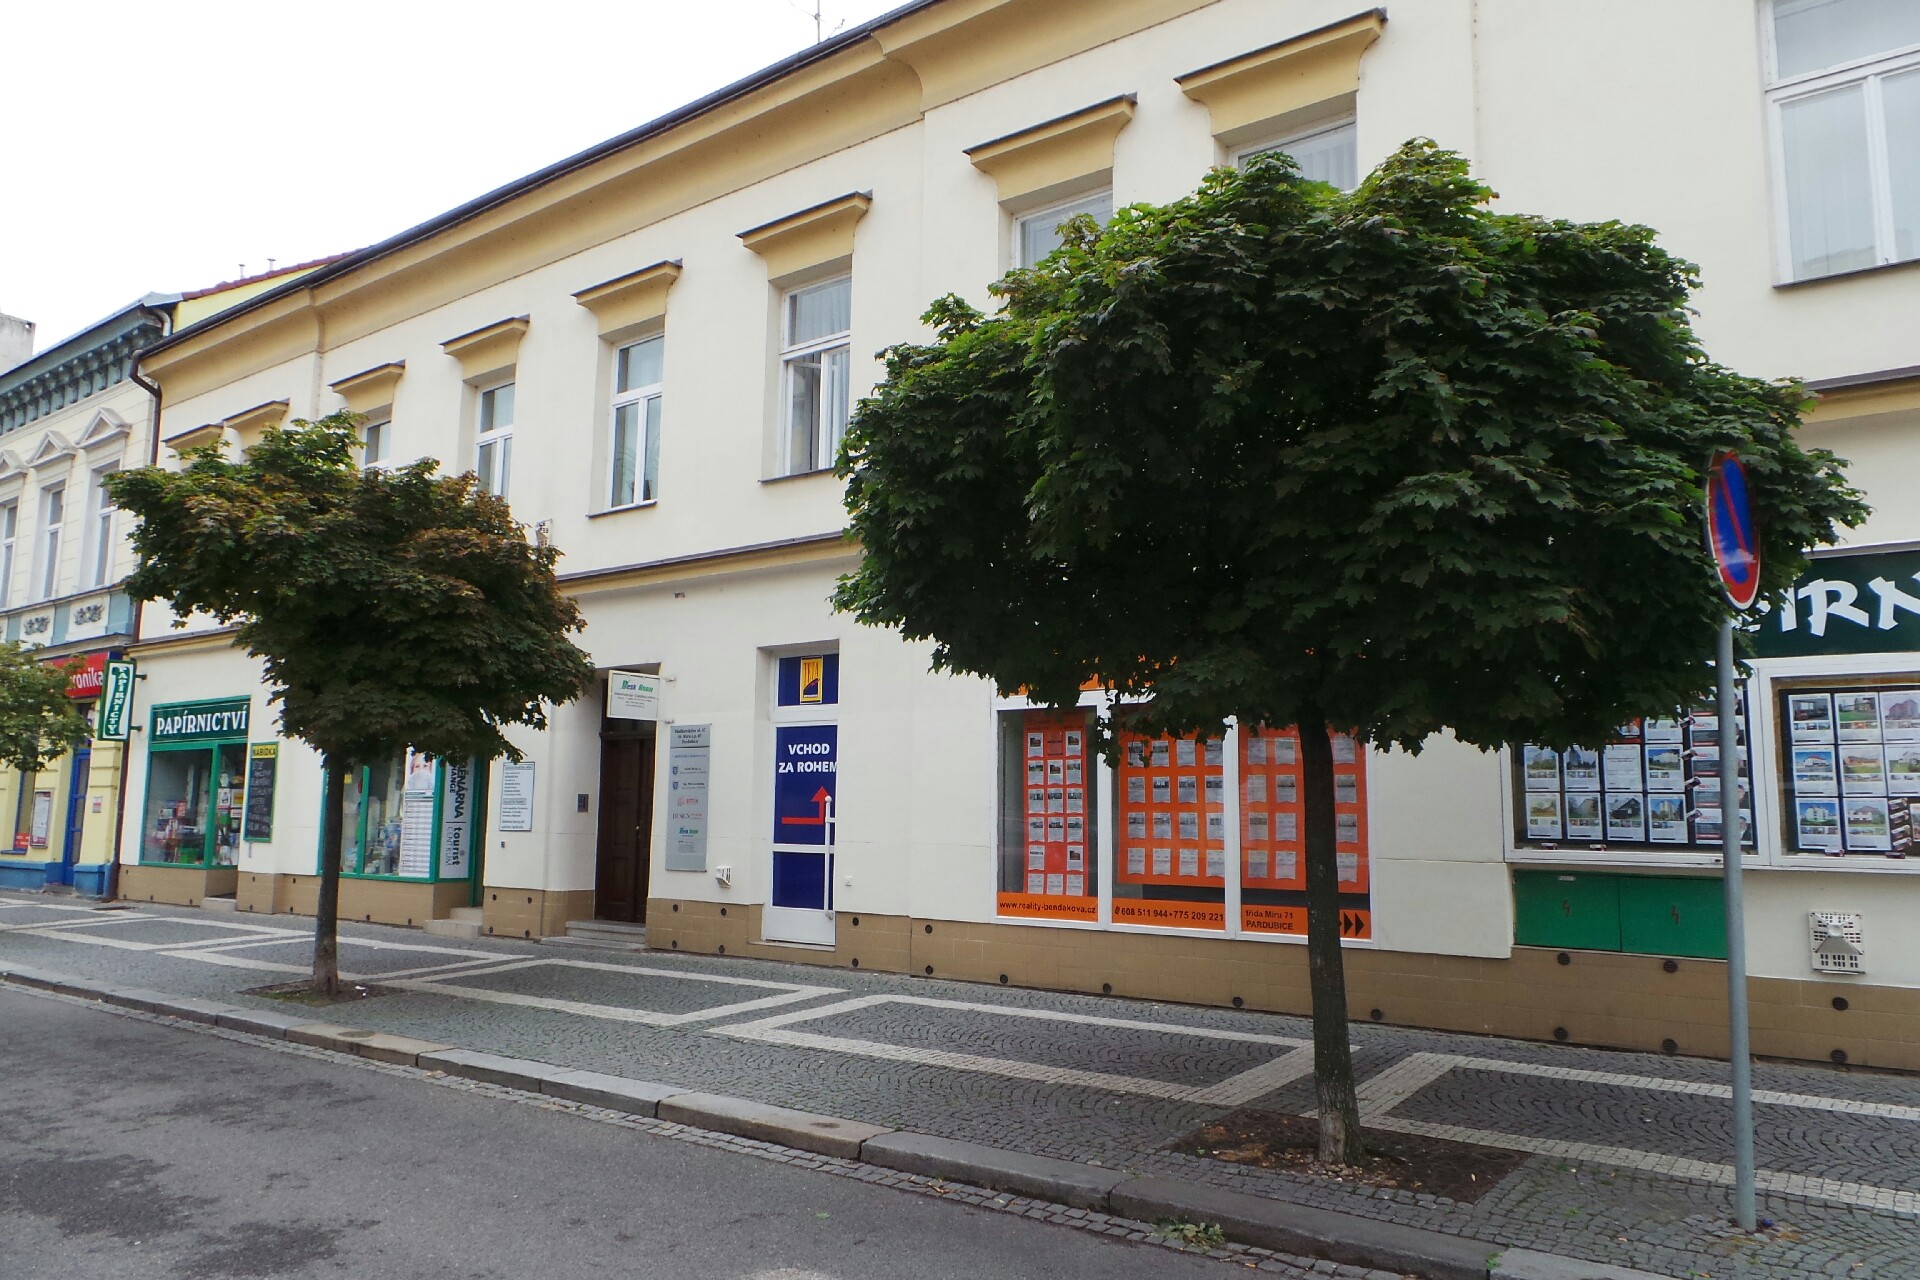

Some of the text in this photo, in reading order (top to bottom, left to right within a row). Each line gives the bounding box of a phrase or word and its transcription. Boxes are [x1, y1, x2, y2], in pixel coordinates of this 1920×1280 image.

[70, 667, 103, 689] ronika
[156, 705, 247, 736] PAPÍRNICTVÍ
[788, 743, 831, 756] VCHOD
[778, 761, 838, 774] ZA ROHEM
[454, 766, 469, 819] ĚNÁRNA
[445, 826, 454, 867] CENTRUM
[452, 826, 464, 866] tourist
[1000, 902, 1096, 914] www.reality-bendakova.cz
[1121, 907, 1224, 921] 608 511 944 775 209 221
[1246, 920, 1294, 931] PARDUBICE
